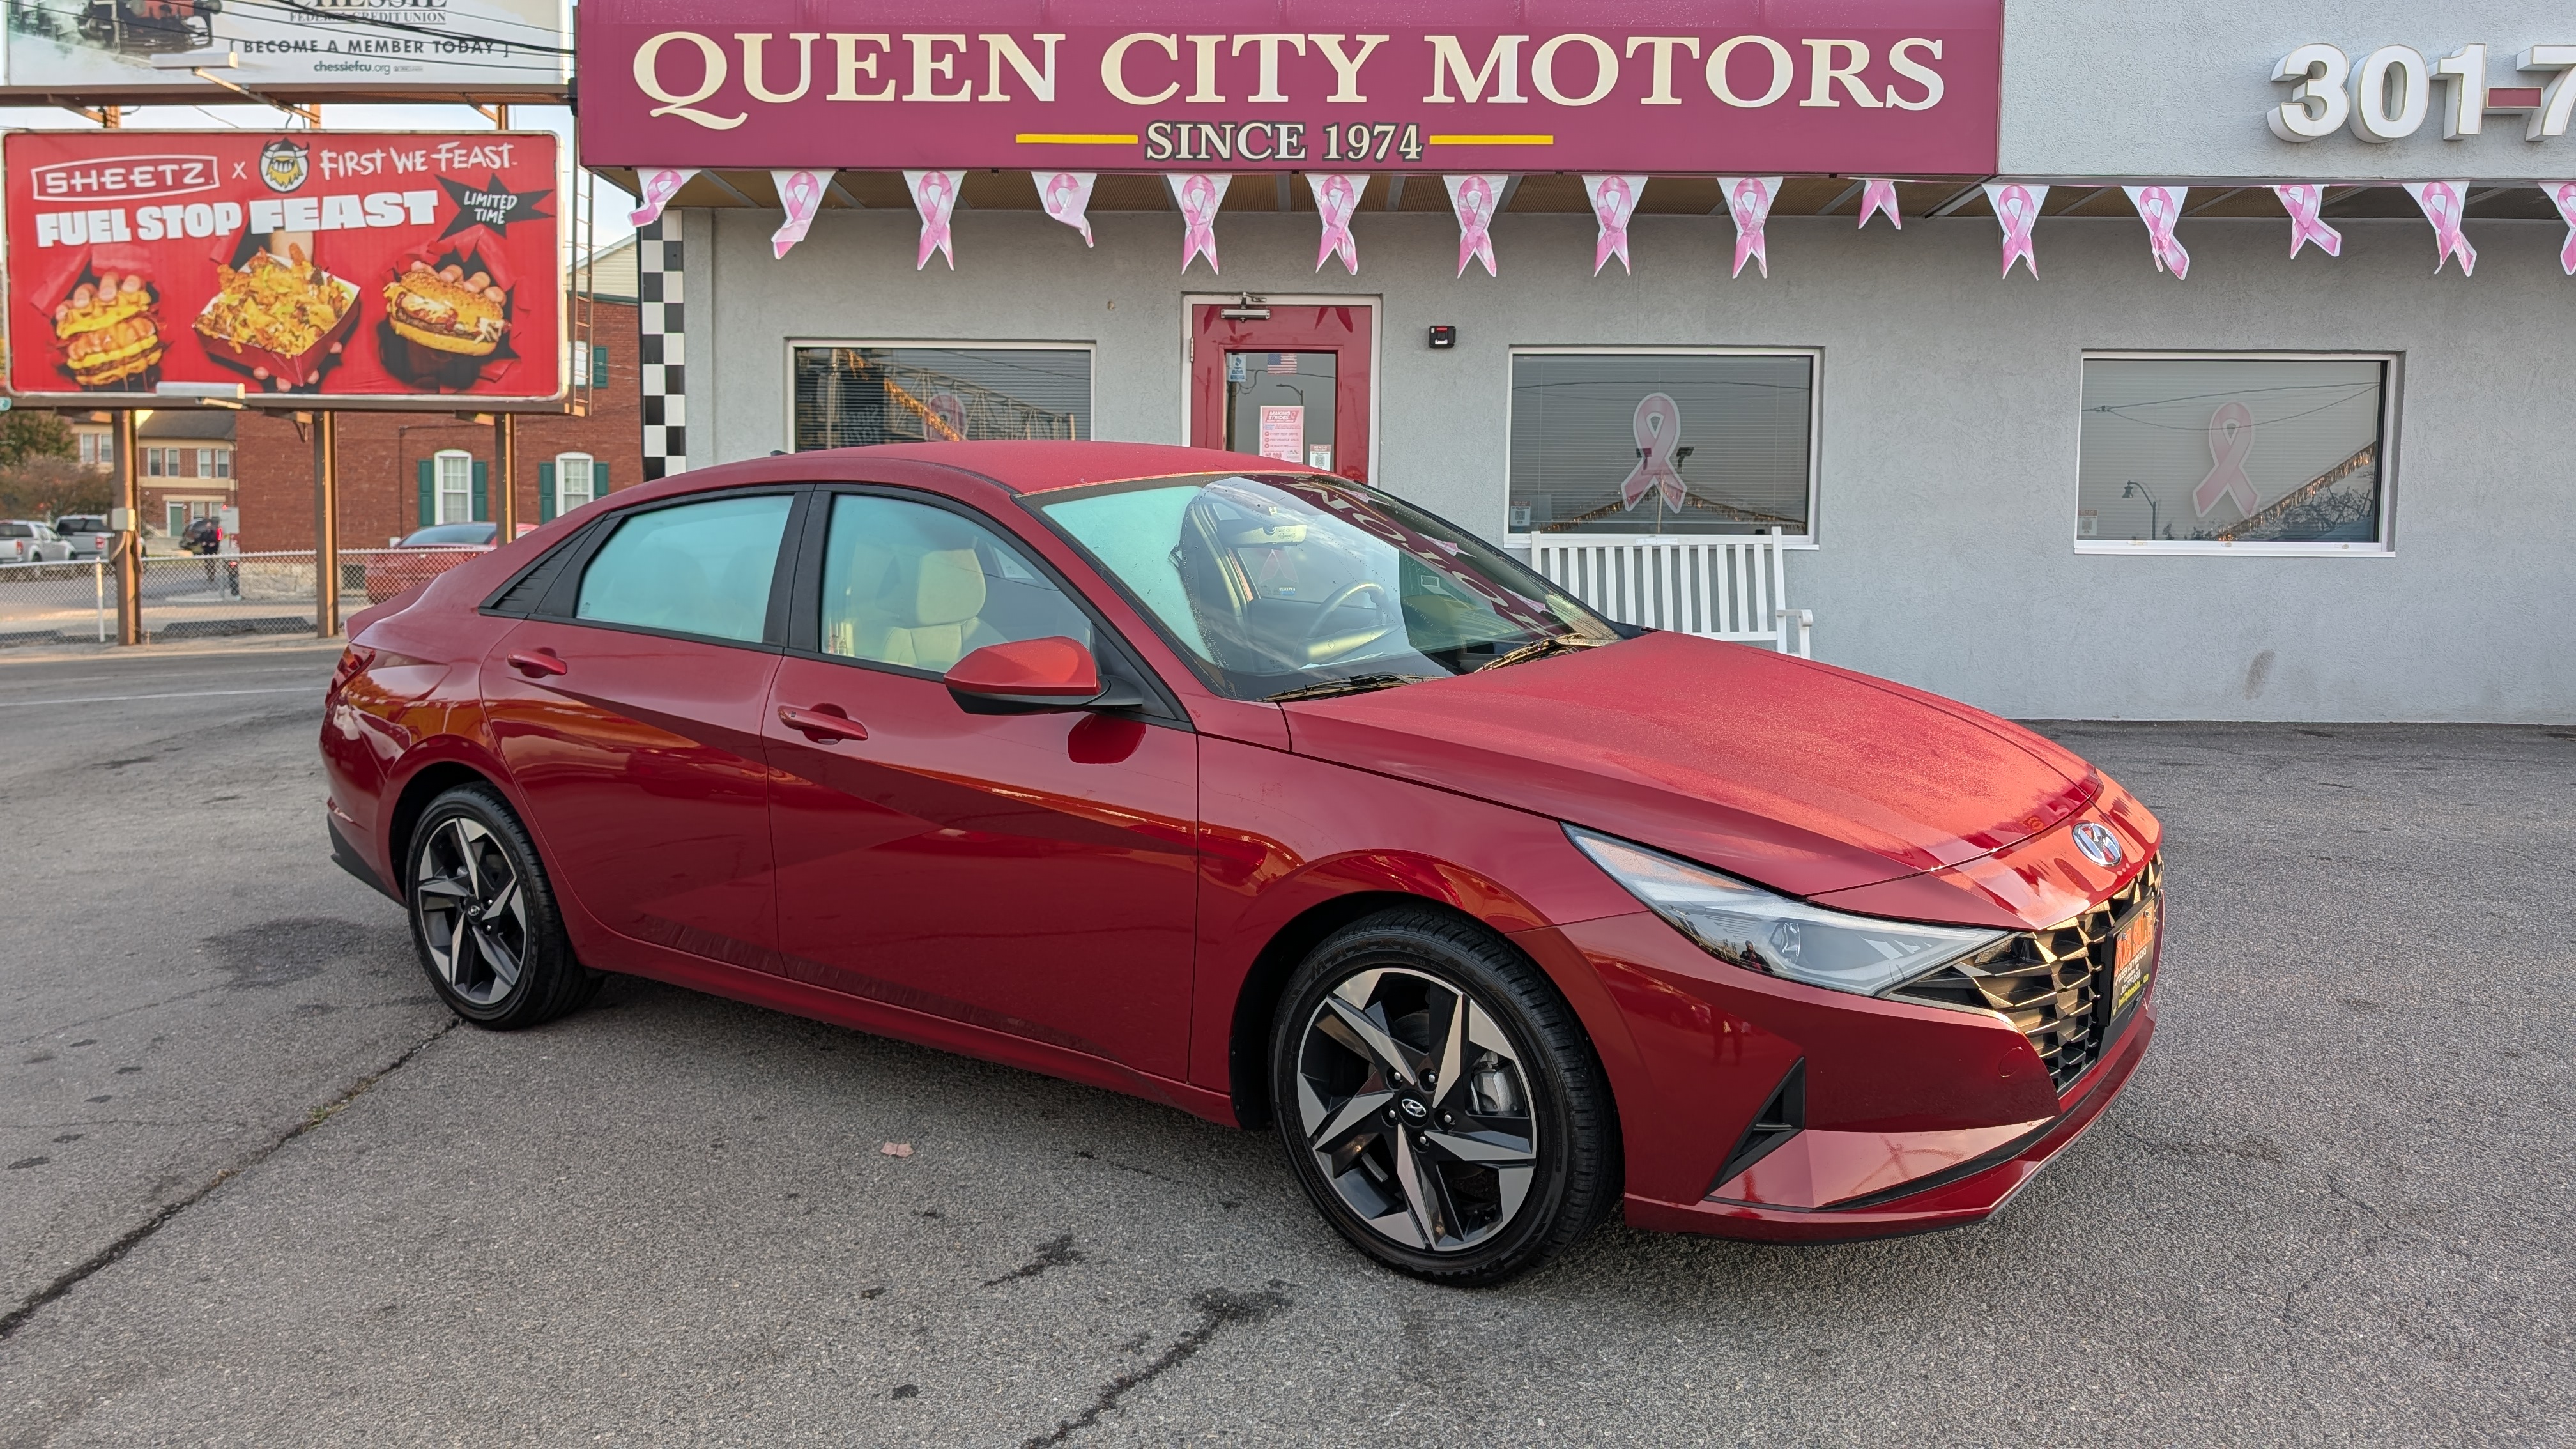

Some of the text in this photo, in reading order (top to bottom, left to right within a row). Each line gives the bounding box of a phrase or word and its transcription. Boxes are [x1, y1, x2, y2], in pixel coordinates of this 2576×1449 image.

[404, 12, 447, 22] UNION
[243, 40, 494, 54] BECOME A MEMBER TODAY
[313, 60, 391, 75] chessiefcu.org
[632, 31, 1945, 130] QUEEN CITY MOTORS
[2267, 42, 2576, 143] 301-7
[1146, 121, 1424, 161] SINCE 1974
[45, 162, 206, 194] SHEETZ
[319, 141, 515, 181] FIRST WE FEAST
[463, 190, 518, 211] LIMITED
[473, 208, 506, 226] TIME
[35, 190, 439, 248] FUEL STOP FEAST
[1309, 937, 1434, 982] MAXXIS
